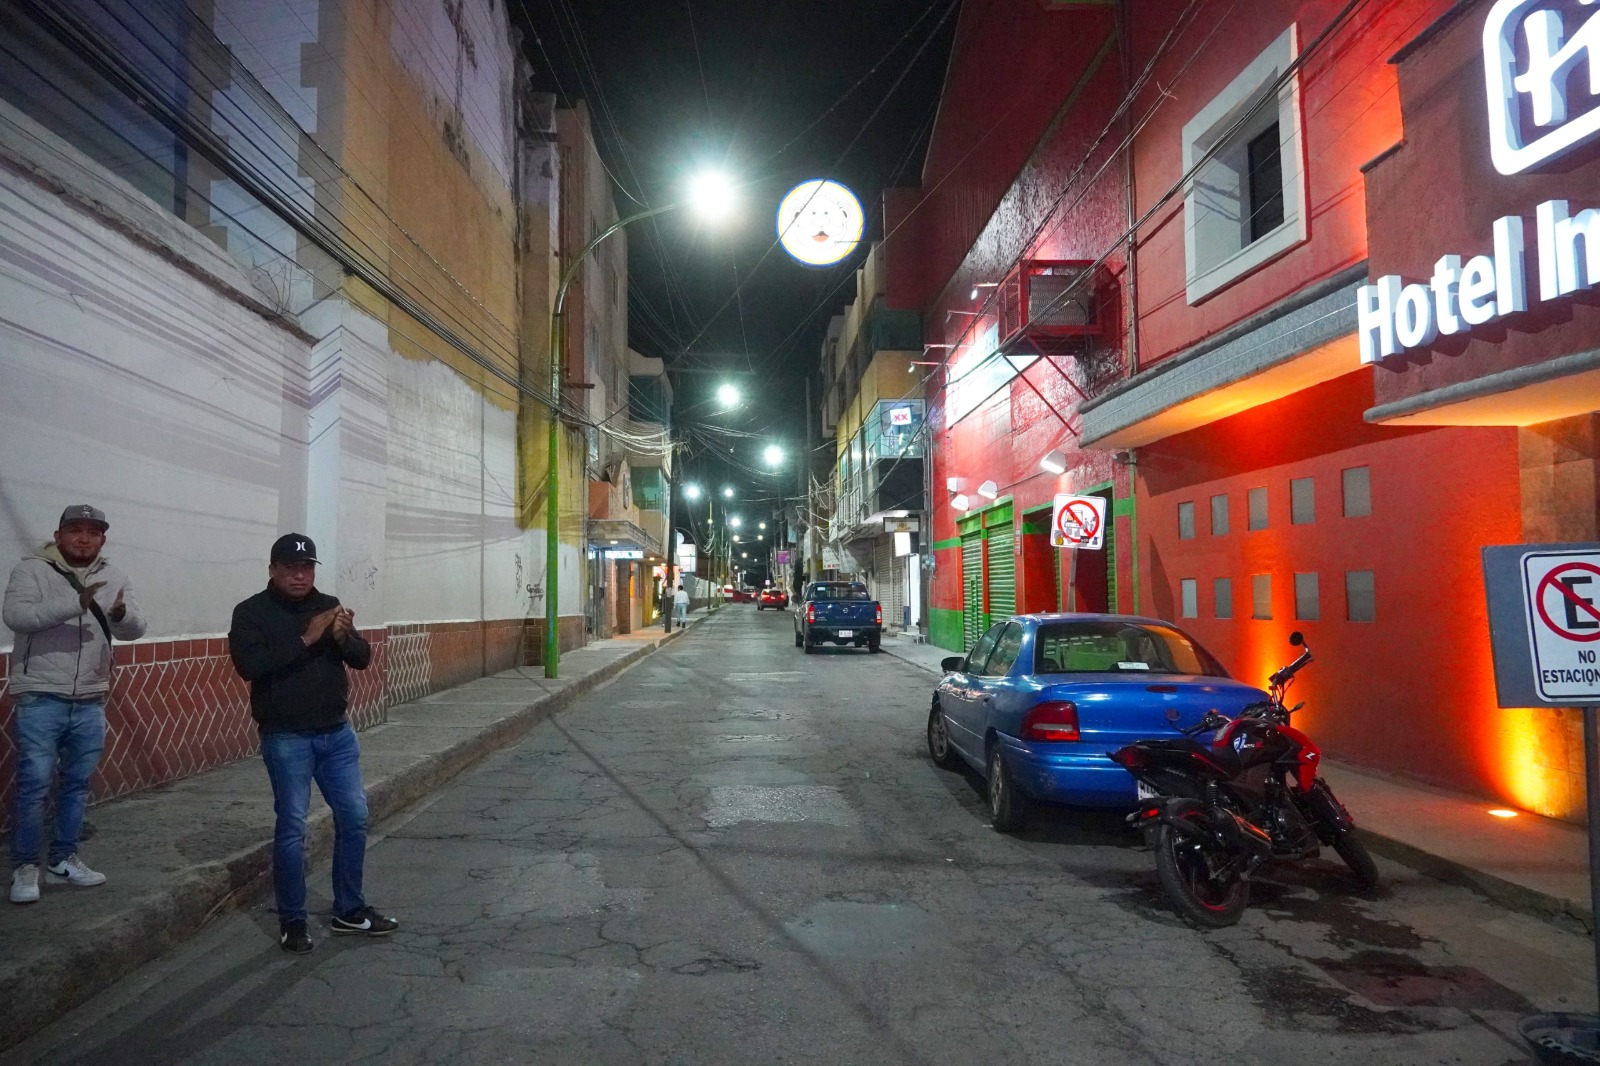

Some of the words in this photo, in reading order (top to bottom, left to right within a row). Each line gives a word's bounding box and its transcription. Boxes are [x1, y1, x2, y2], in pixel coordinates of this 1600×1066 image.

[1357, 215, 1527, 365] Hotel
[1561, 576, 1600, 629] E
[1577, 649, 1596, 664] NO
